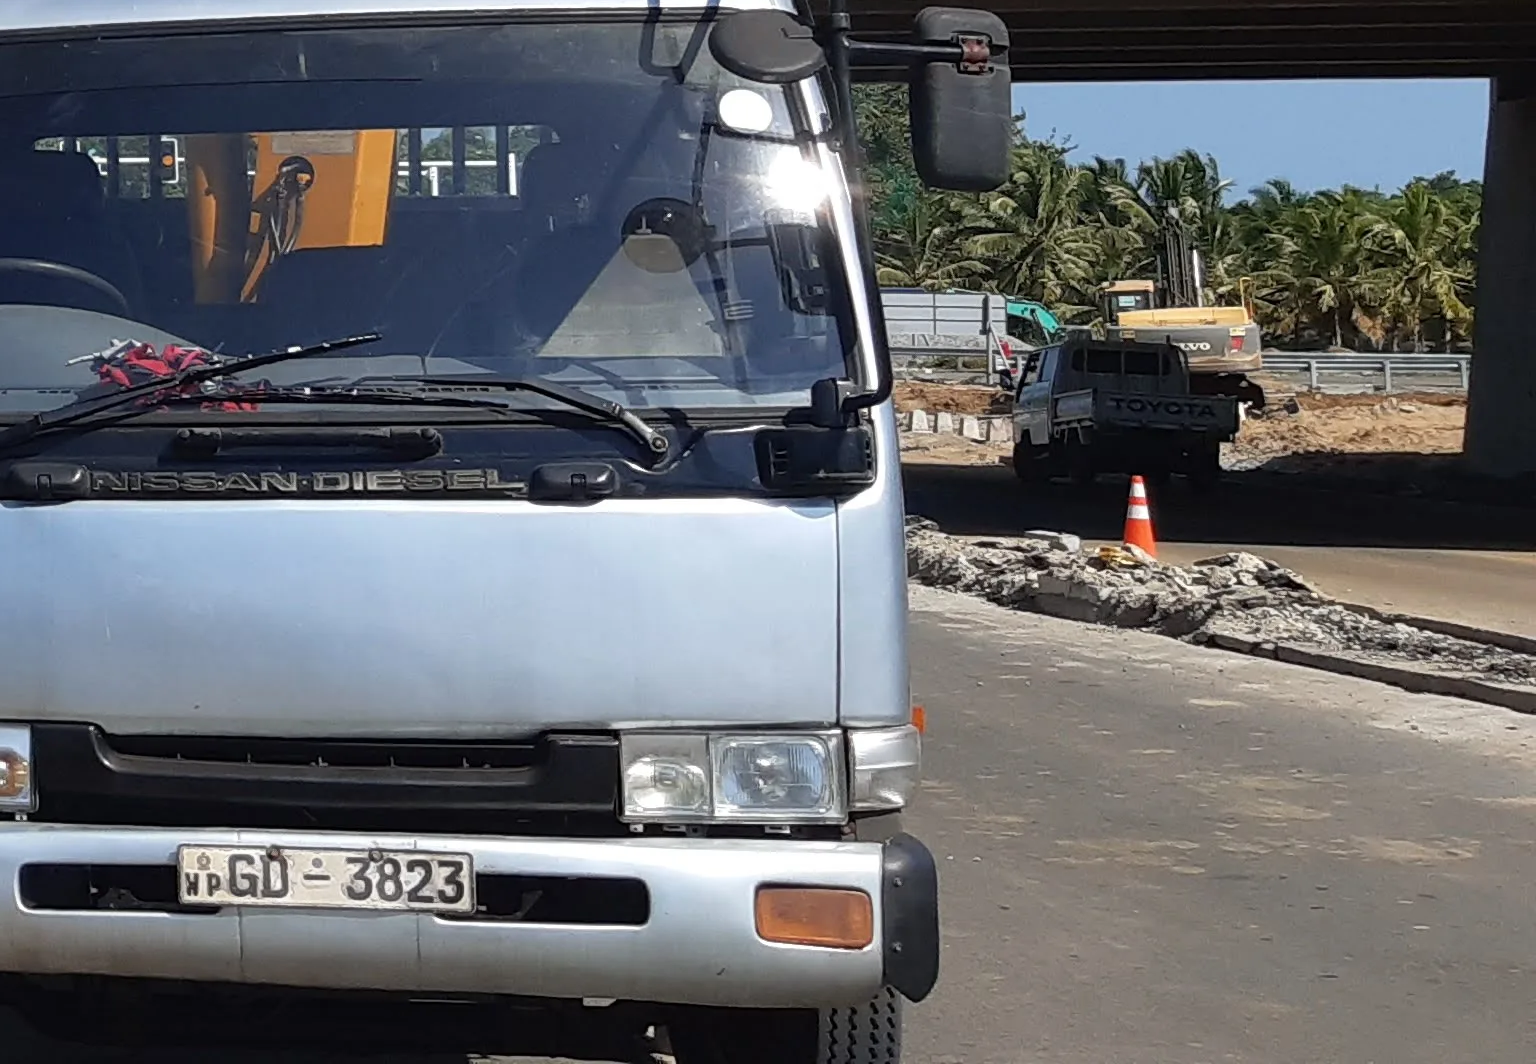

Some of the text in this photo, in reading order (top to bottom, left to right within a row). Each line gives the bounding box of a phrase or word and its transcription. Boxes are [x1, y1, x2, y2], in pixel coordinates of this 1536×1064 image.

[1108, 397, 1216, 417] TOYOTA
[92, 468, 527, 493] NISSAN DIESEL
[184, 872, 222, 897] WP
[228, 853, 289, 898] GD
[345, 856, 465, 904] 3823
